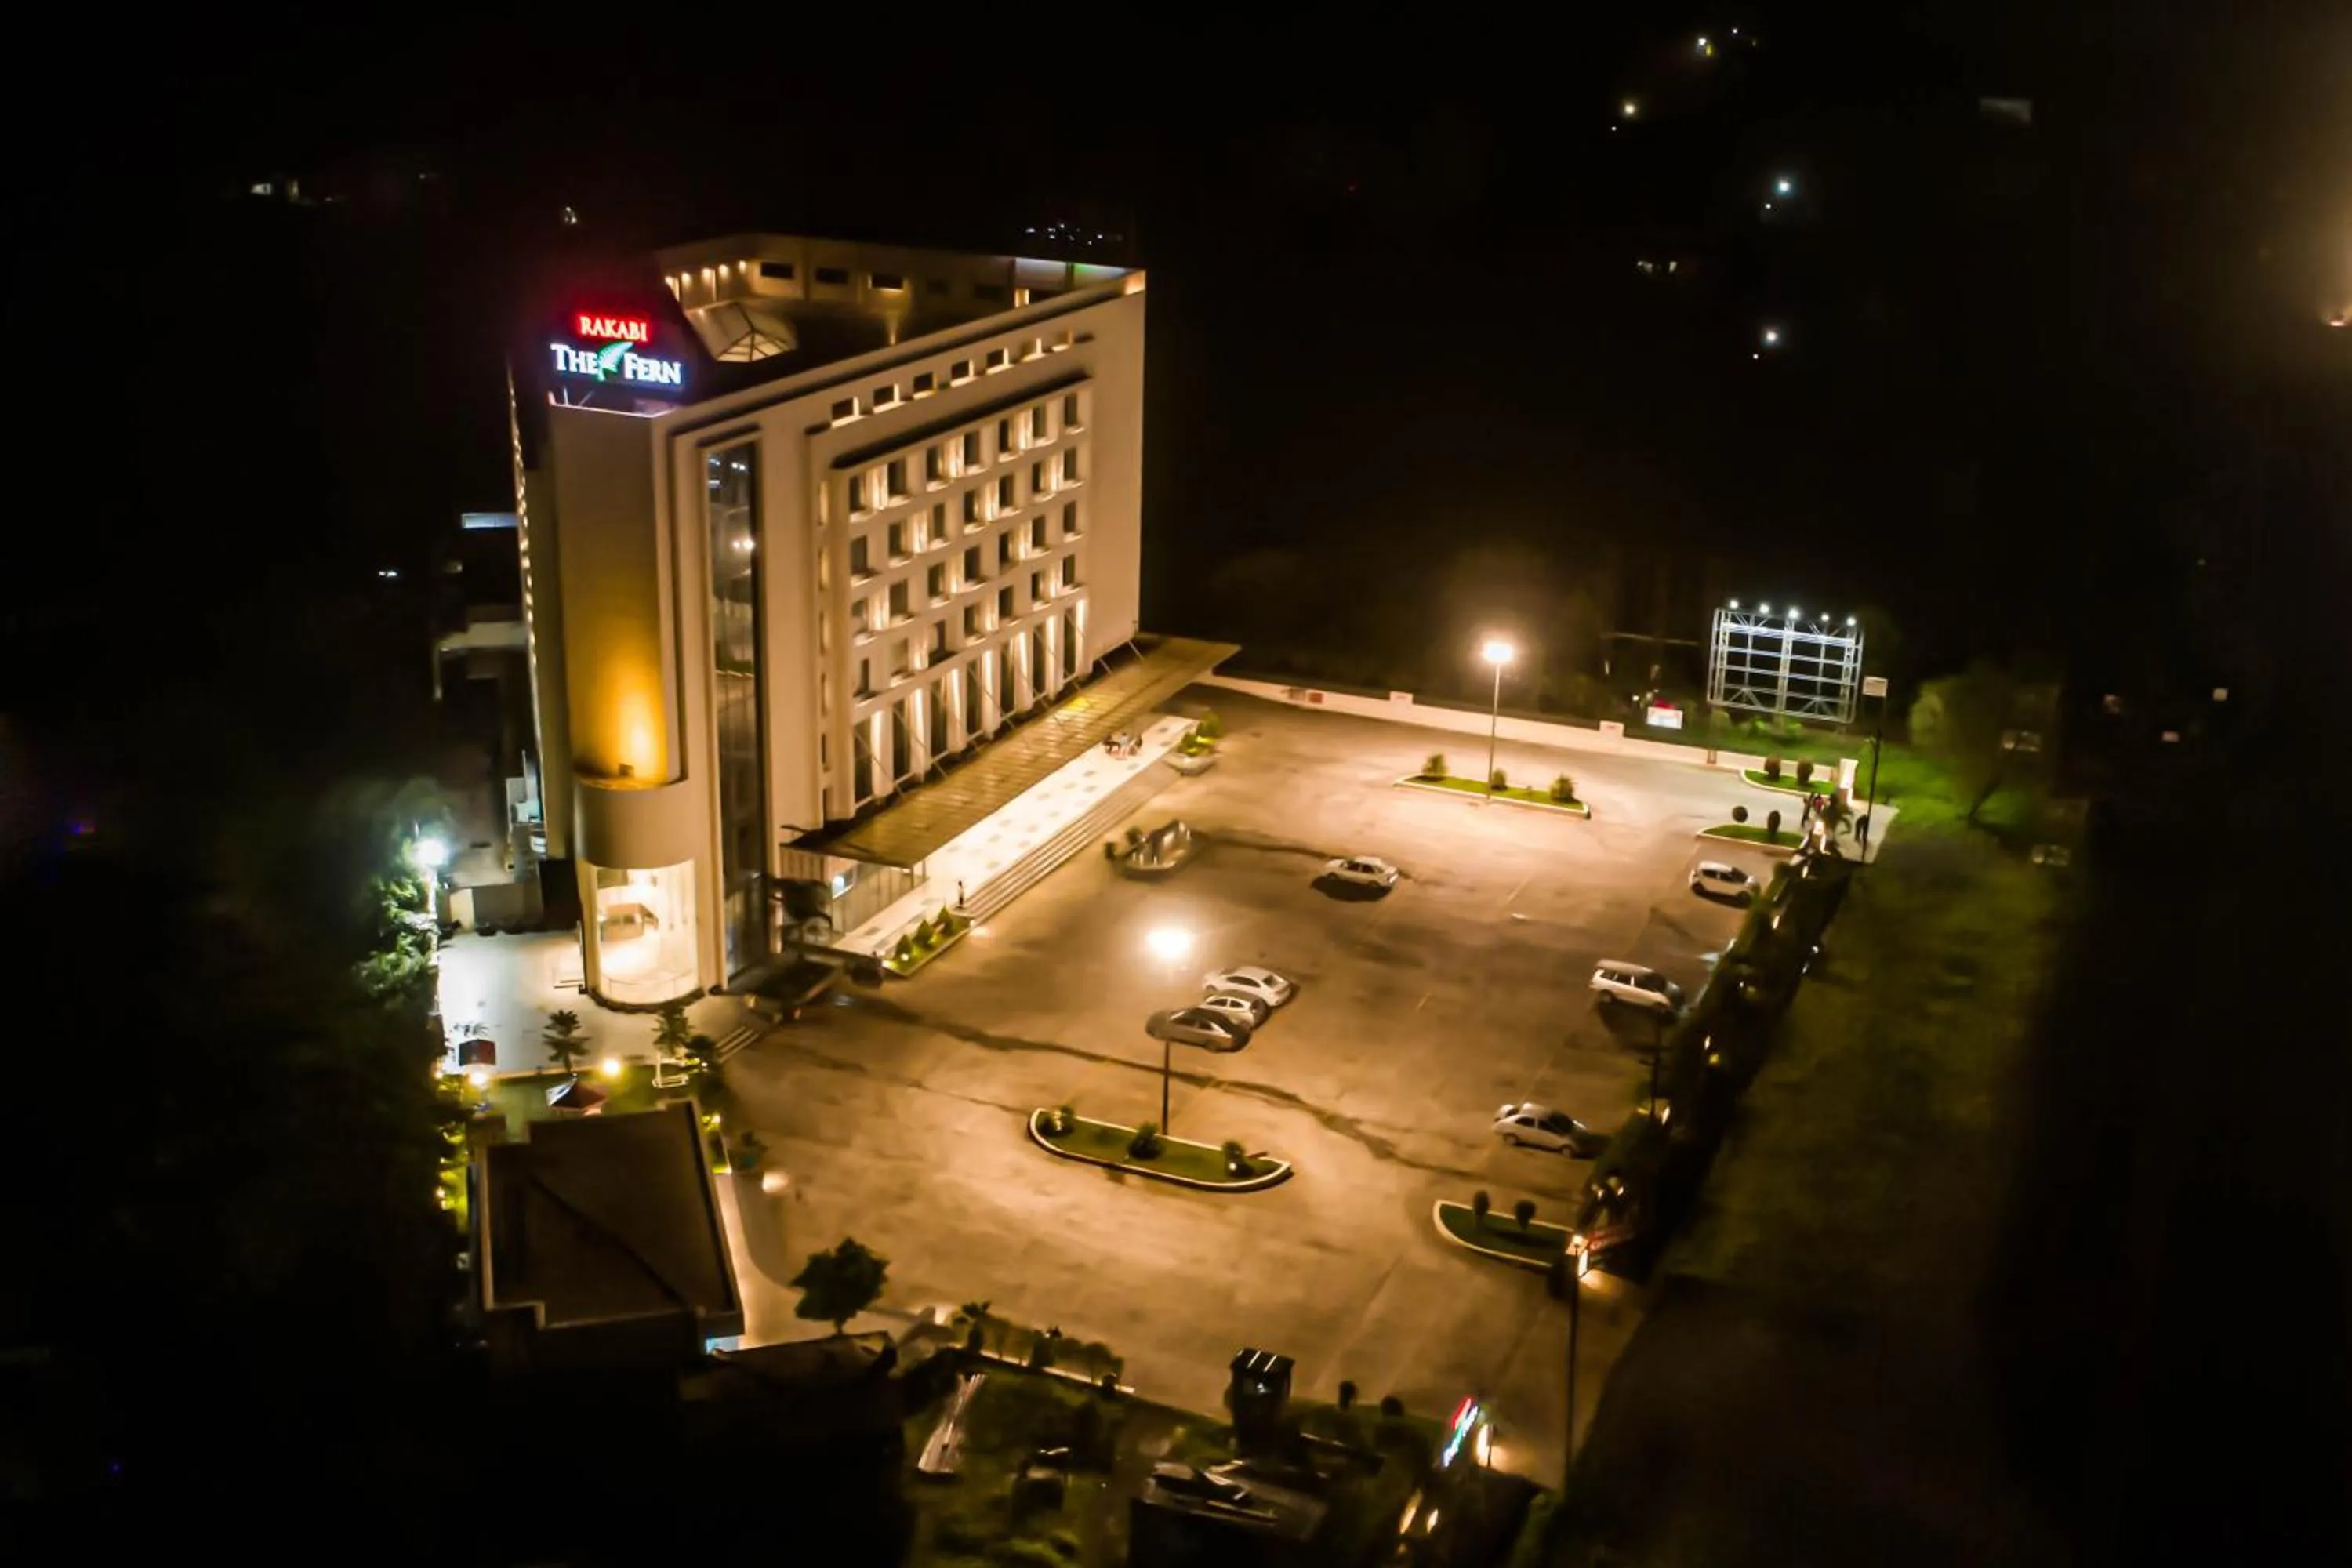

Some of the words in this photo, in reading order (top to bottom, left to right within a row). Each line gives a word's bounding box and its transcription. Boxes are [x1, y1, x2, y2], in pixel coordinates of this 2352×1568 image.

[580, 316, 648, 342] RAKABI
[550, 343, 598, 375] THE
[624, 353, 681, 384] FERN
